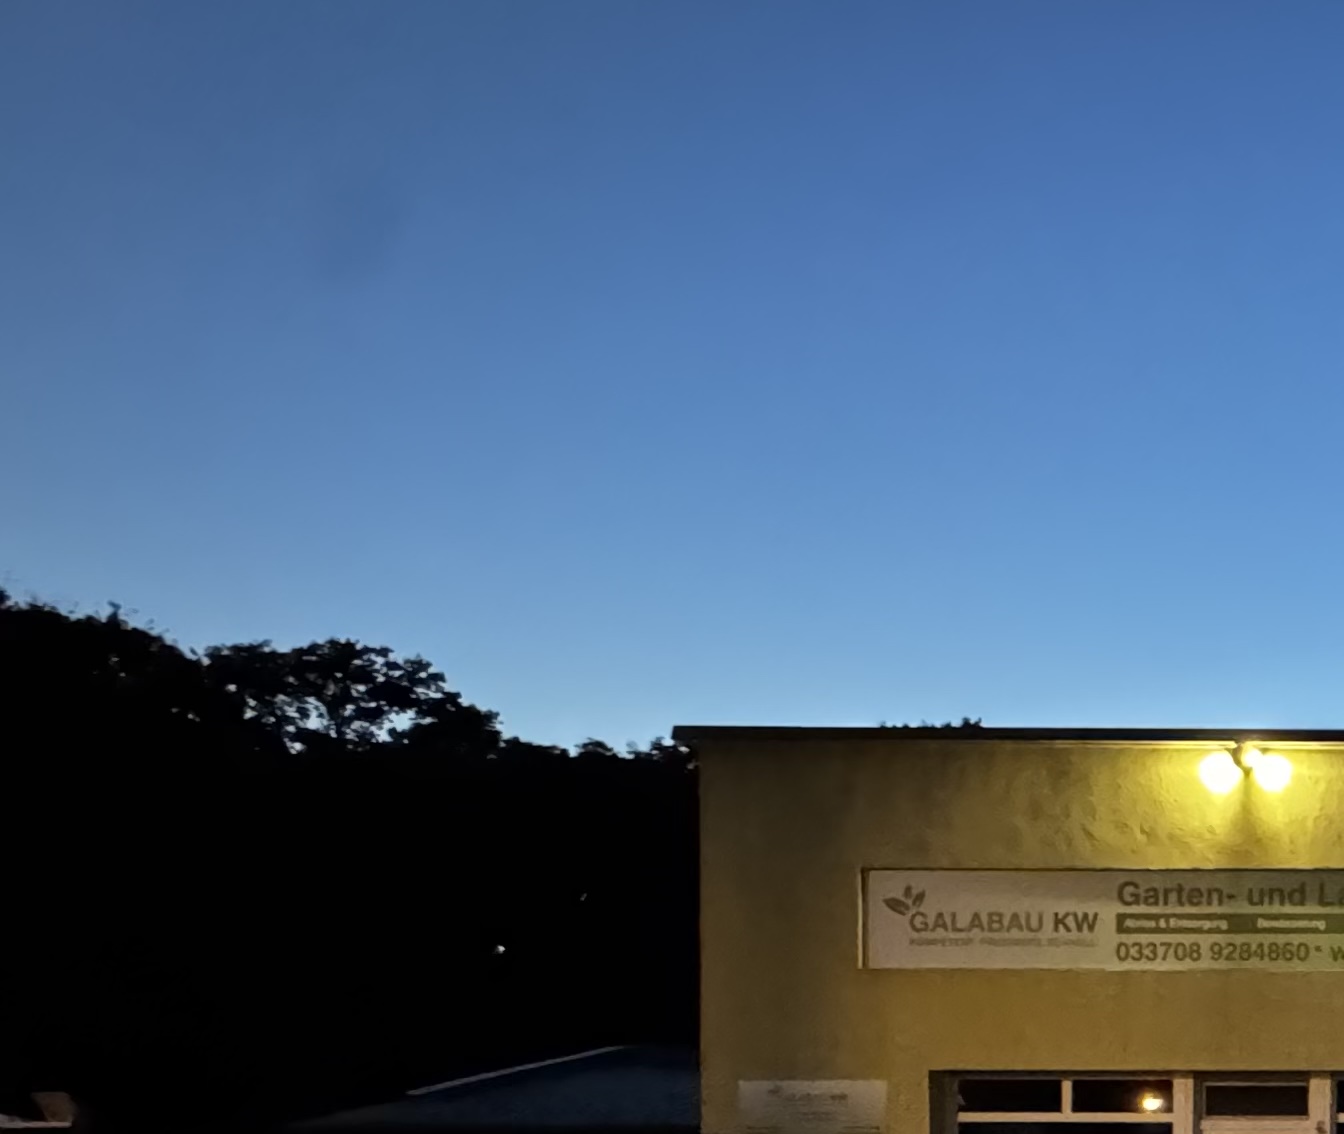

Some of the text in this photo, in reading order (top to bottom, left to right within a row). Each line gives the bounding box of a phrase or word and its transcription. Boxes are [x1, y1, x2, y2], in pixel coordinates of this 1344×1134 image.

[1117, 881, 1235, 907] Garten-
[1247, 882, 1306, 907] und
[909, 911, 1044, 933] GALABAU
[1053, 911, 1099, 933] KW
[1115, 942, 1310, 962] 033708 9284860
